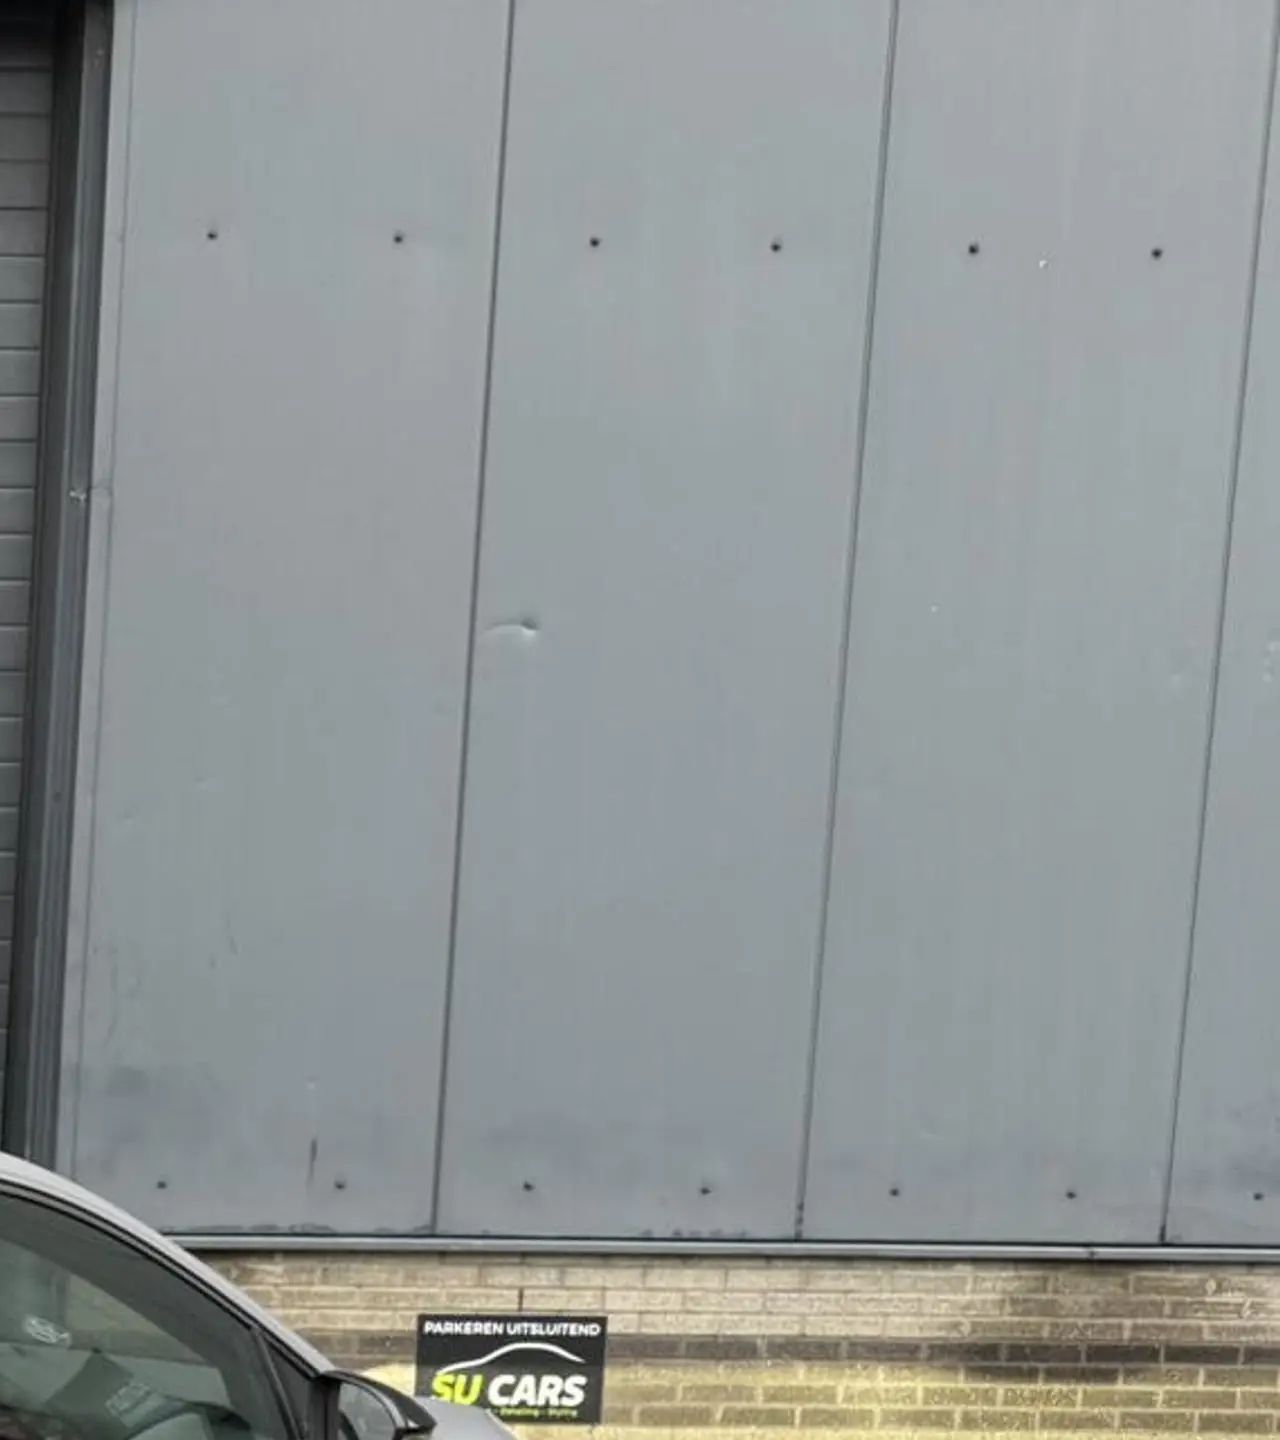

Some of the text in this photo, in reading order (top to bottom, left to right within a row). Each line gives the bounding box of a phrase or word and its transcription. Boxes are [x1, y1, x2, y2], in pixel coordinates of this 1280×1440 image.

[424, 1320, 602, 1338] PARKEREN UITSLUITEND
[431, 1372, 589, 1408] SU CARS
